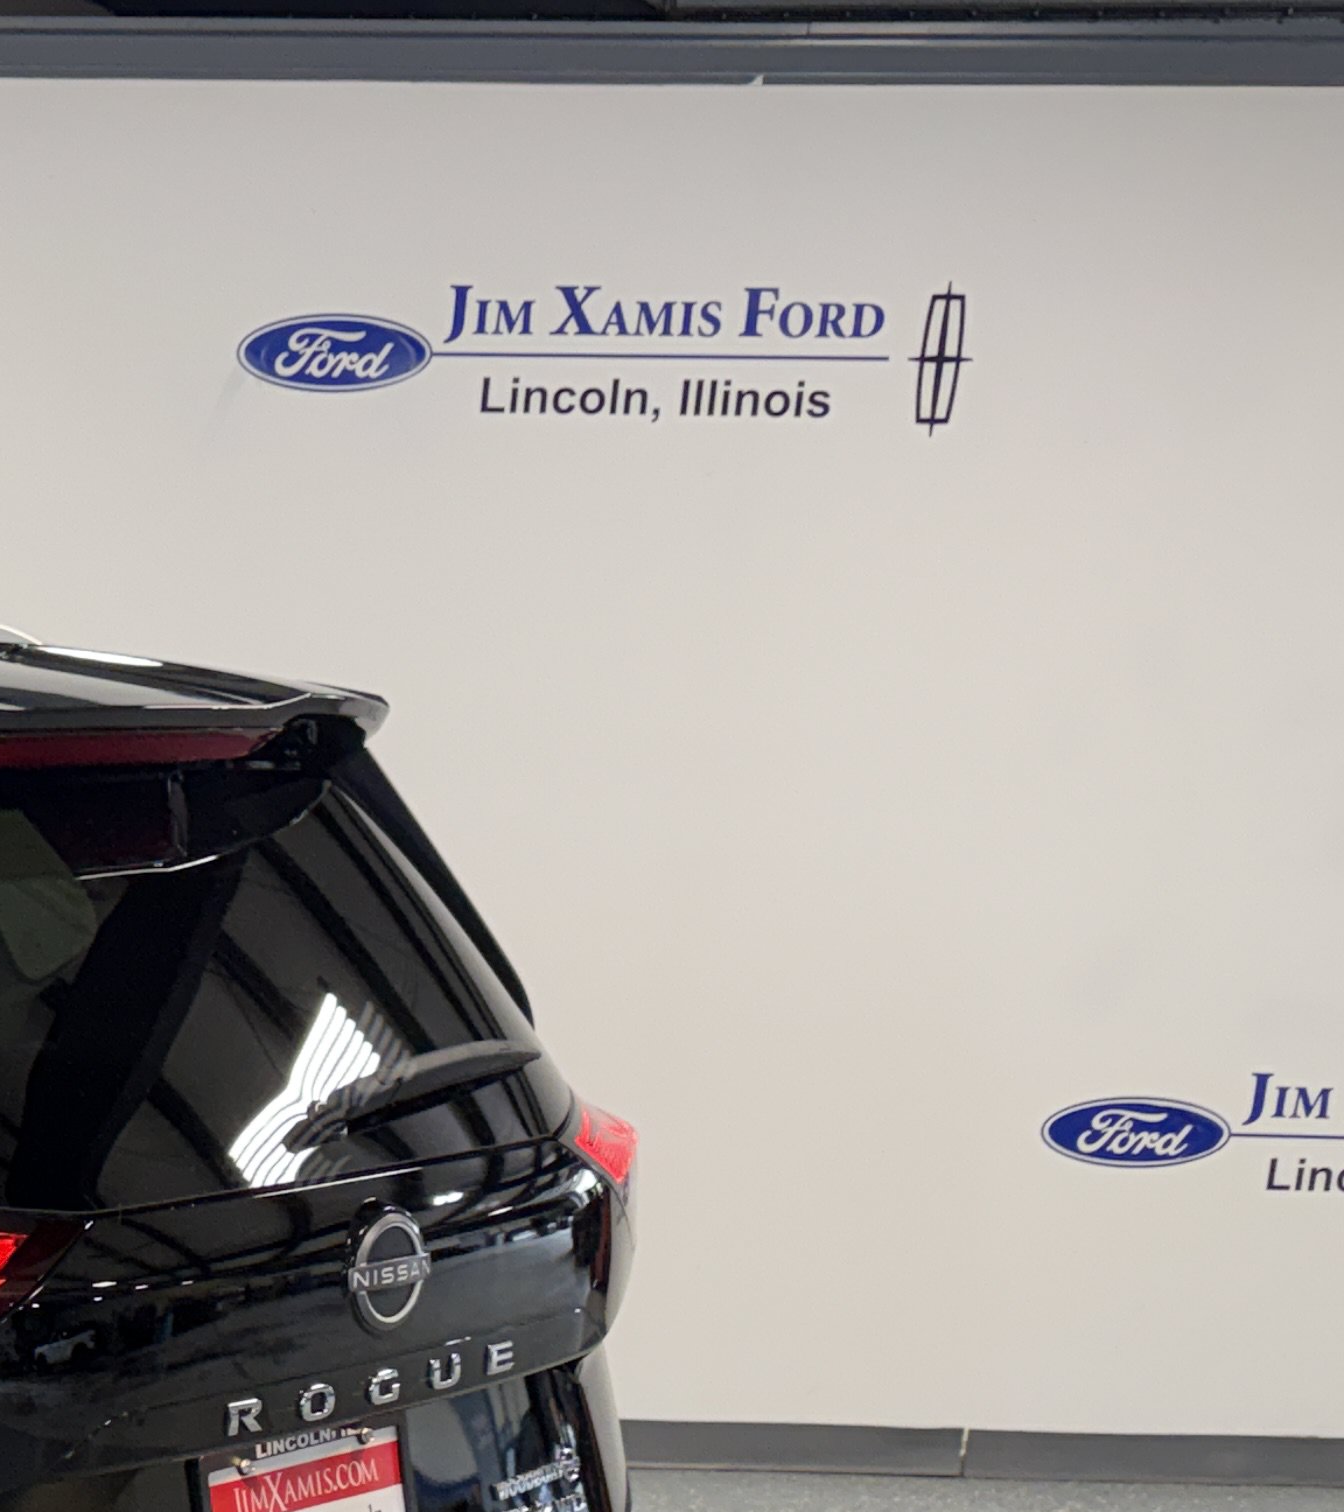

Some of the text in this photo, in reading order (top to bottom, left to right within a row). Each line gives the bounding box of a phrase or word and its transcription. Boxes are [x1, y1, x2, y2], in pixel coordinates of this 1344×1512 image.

[443, 285, 886, 344] JIM XAMIS FORD
[273, 326, 393, 381] Ford
[479, 376, 832, 423] Lincoln, Illinois
[1242, 1072, 1334, 1126] JIM
[1076, 1107, 1193, 1157] Ford
[352, 1259, 431, 1290] NISSAN
[227, 1340, 516, 1437] ROGUE
